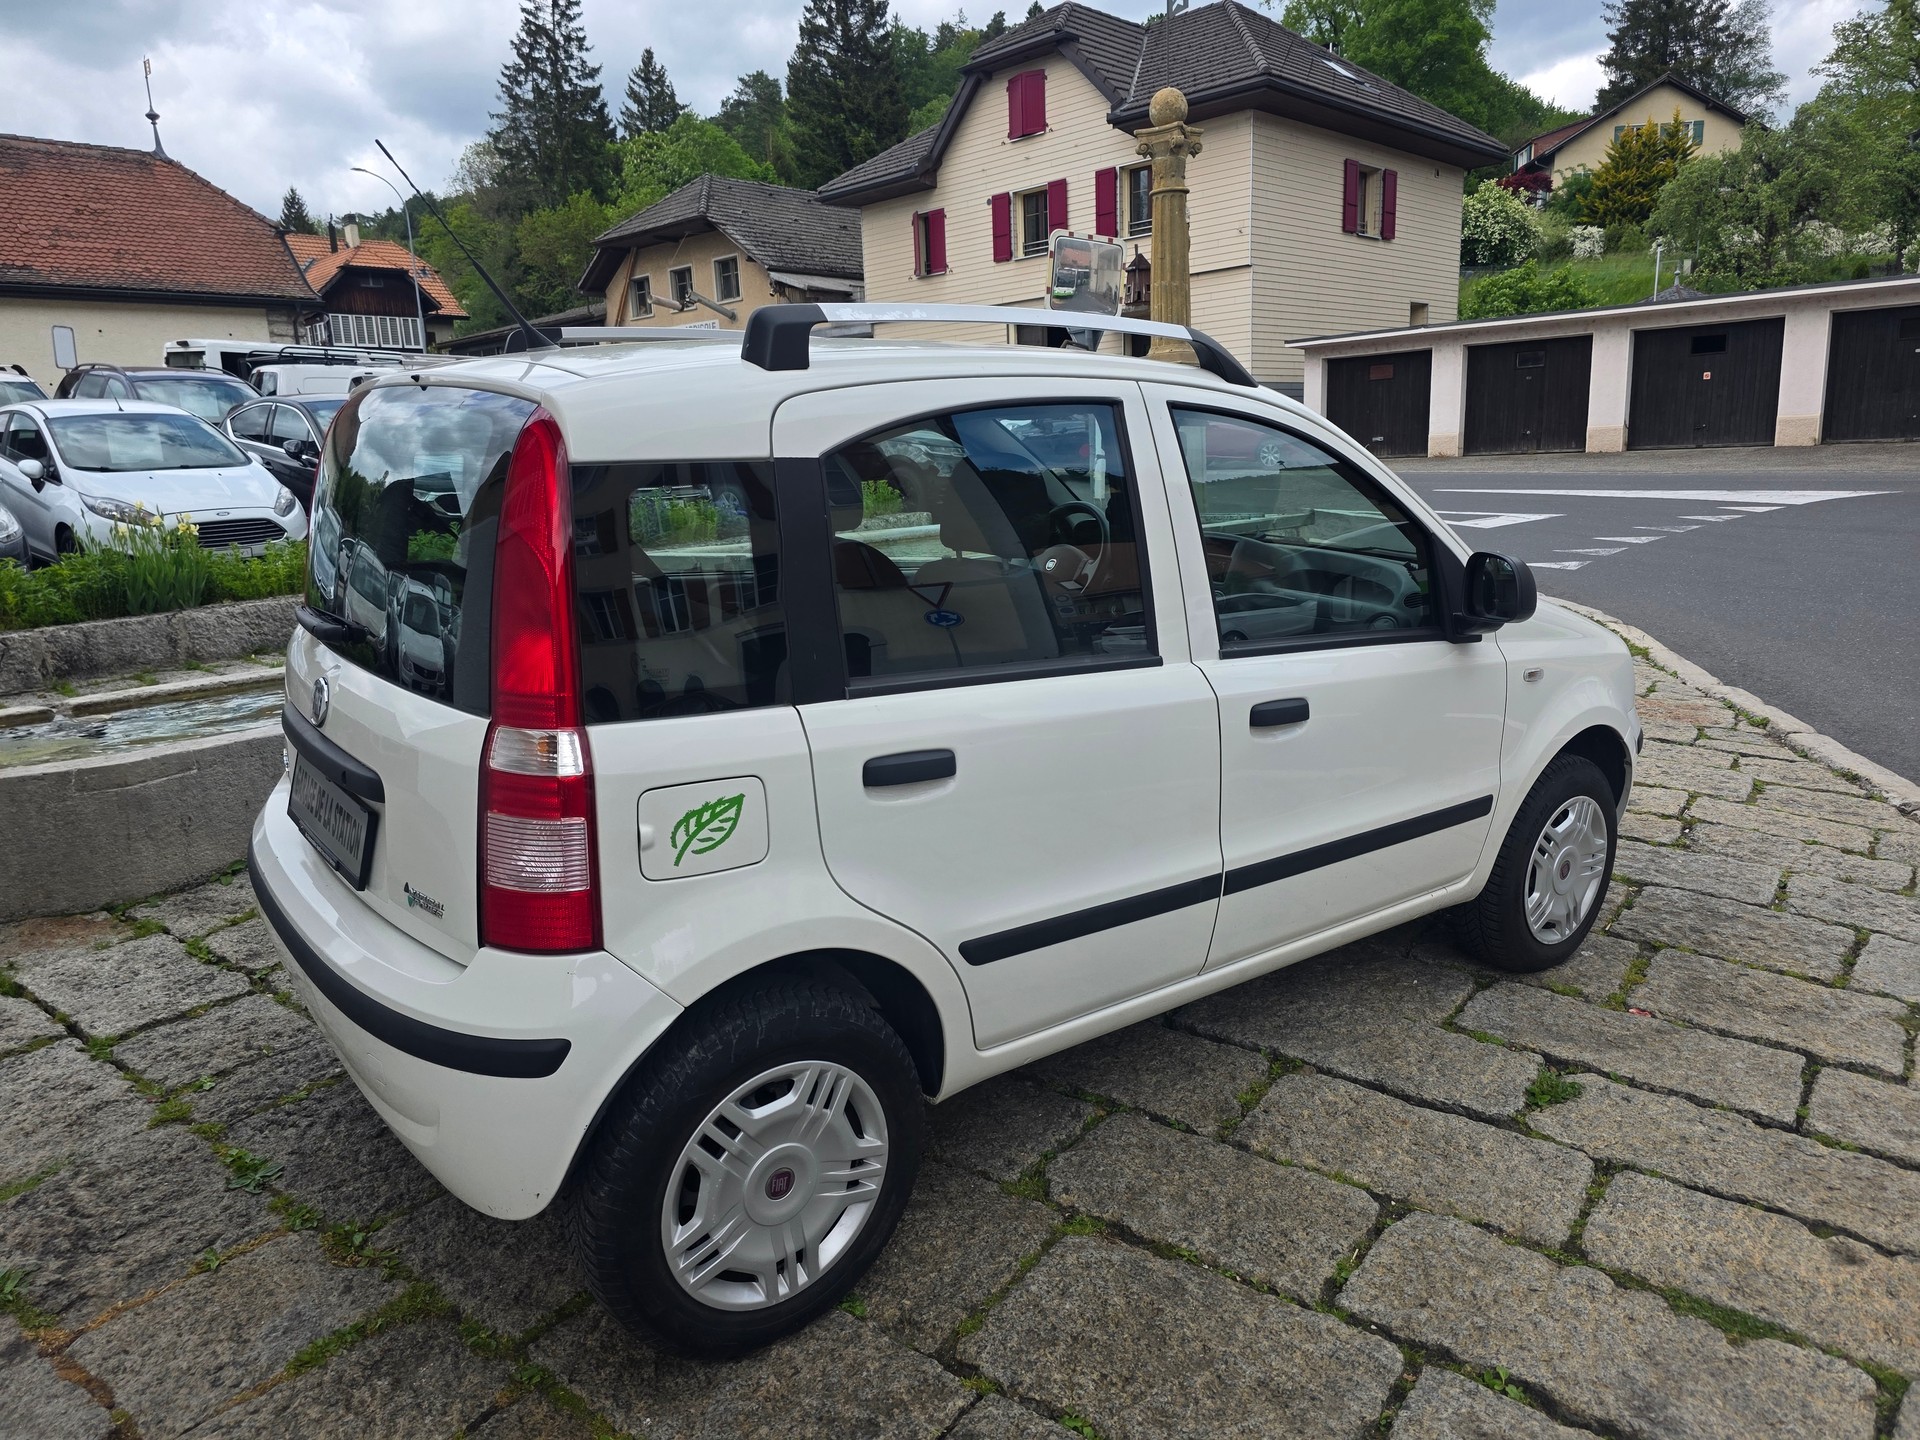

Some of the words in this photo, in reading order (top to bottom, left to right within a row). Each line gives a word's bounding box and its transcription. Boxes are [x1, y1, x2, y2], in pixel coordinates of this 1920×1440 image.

[315, 784, 326, 824] DE
[323, 794, 334, 832] LA
[332, 802, 363, 861] STATION
[771, 1176, 789, 1193] FIAT
